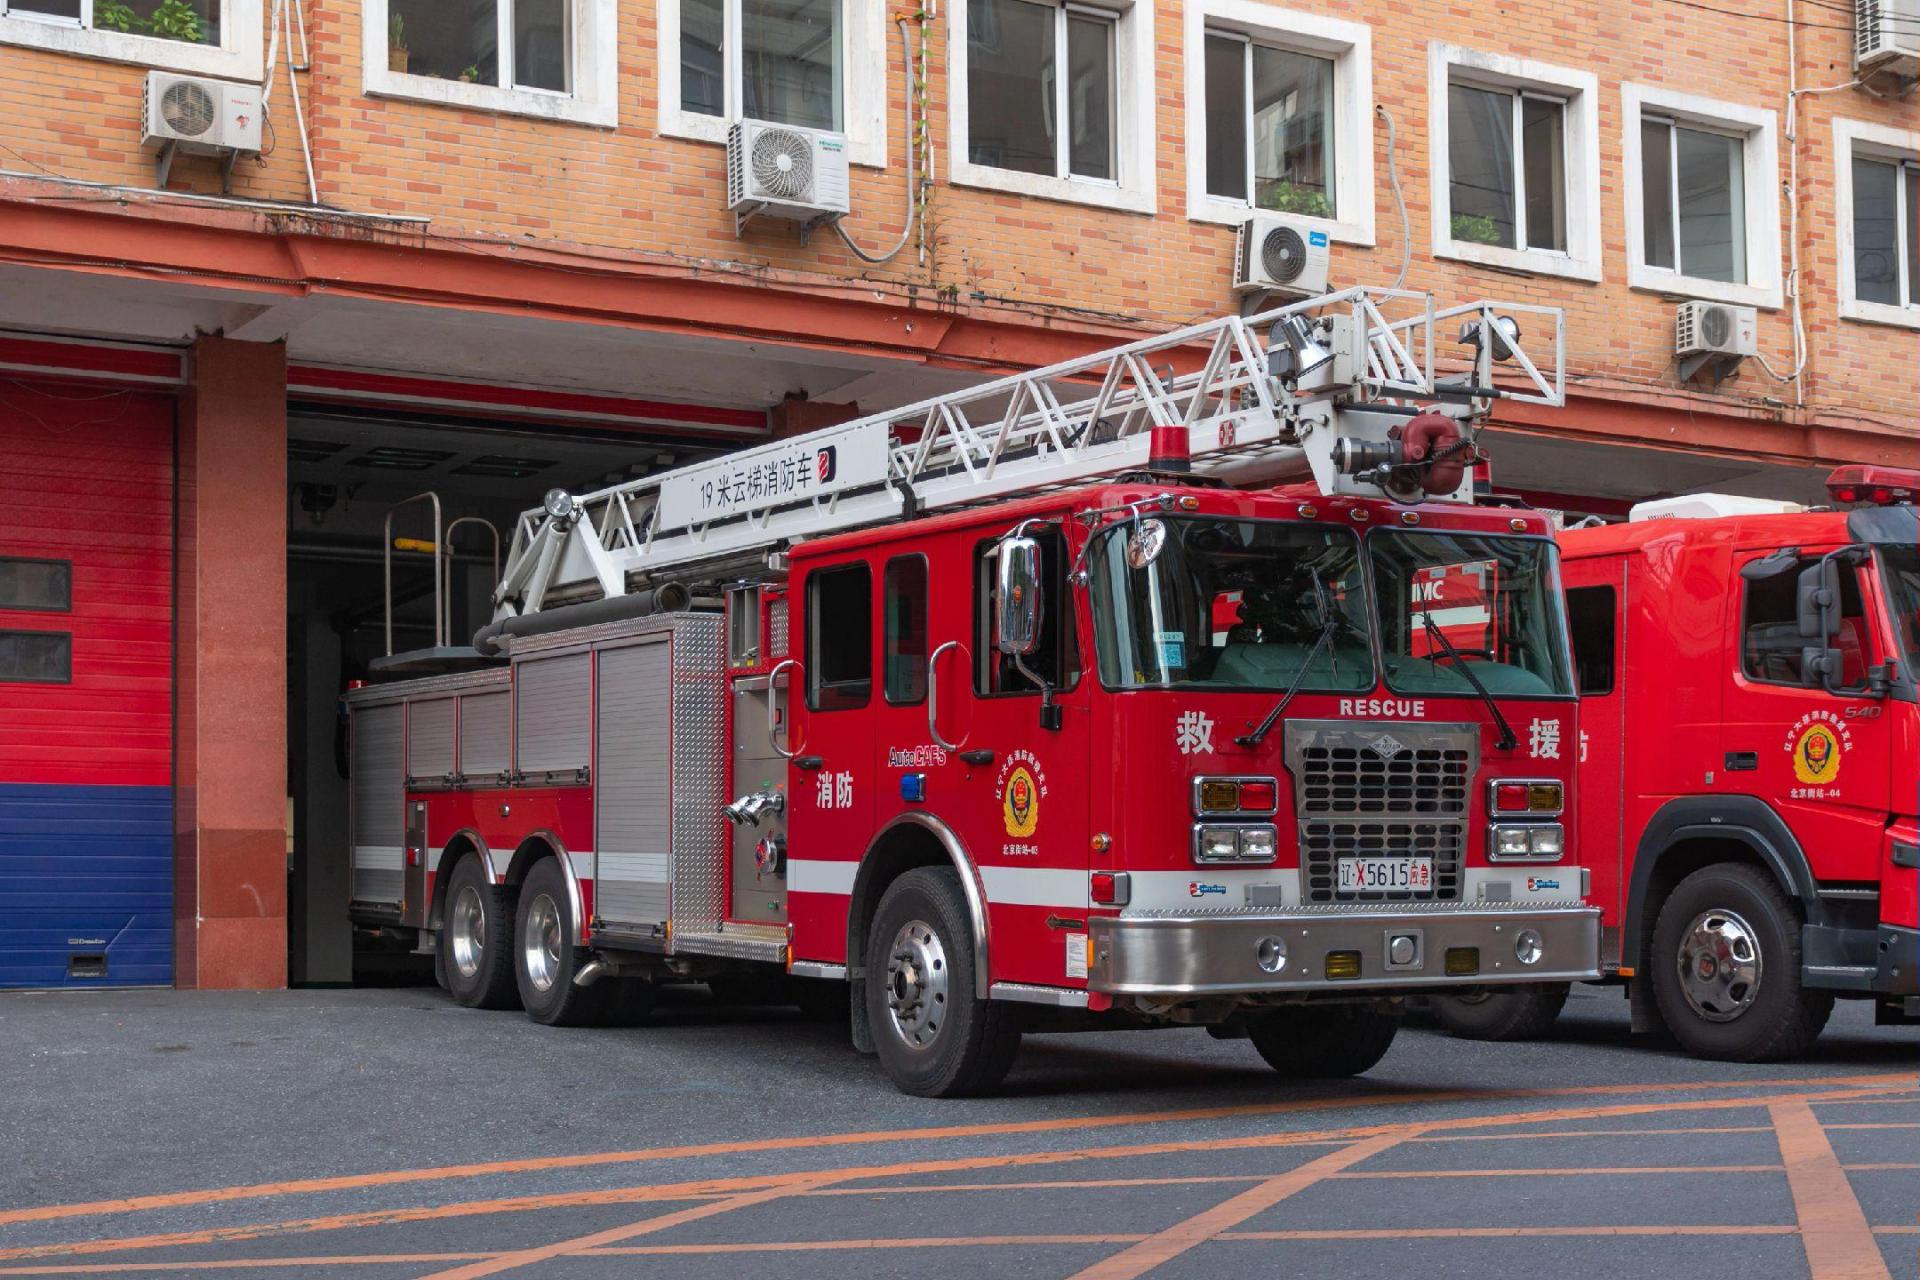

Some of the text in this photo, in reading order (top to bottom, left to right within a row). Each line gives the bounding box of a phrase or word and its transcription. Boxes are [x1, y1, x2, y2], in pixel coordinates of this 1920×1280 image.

[701, 452, 812, 509] 19 米云梯消防车
[1340, 699, 1425, 717] RESCUE
[1176, 710, 1214, 755] 救
[1529, 717, 1560, 759] 援
[816, 770, 853, 808] 消防
